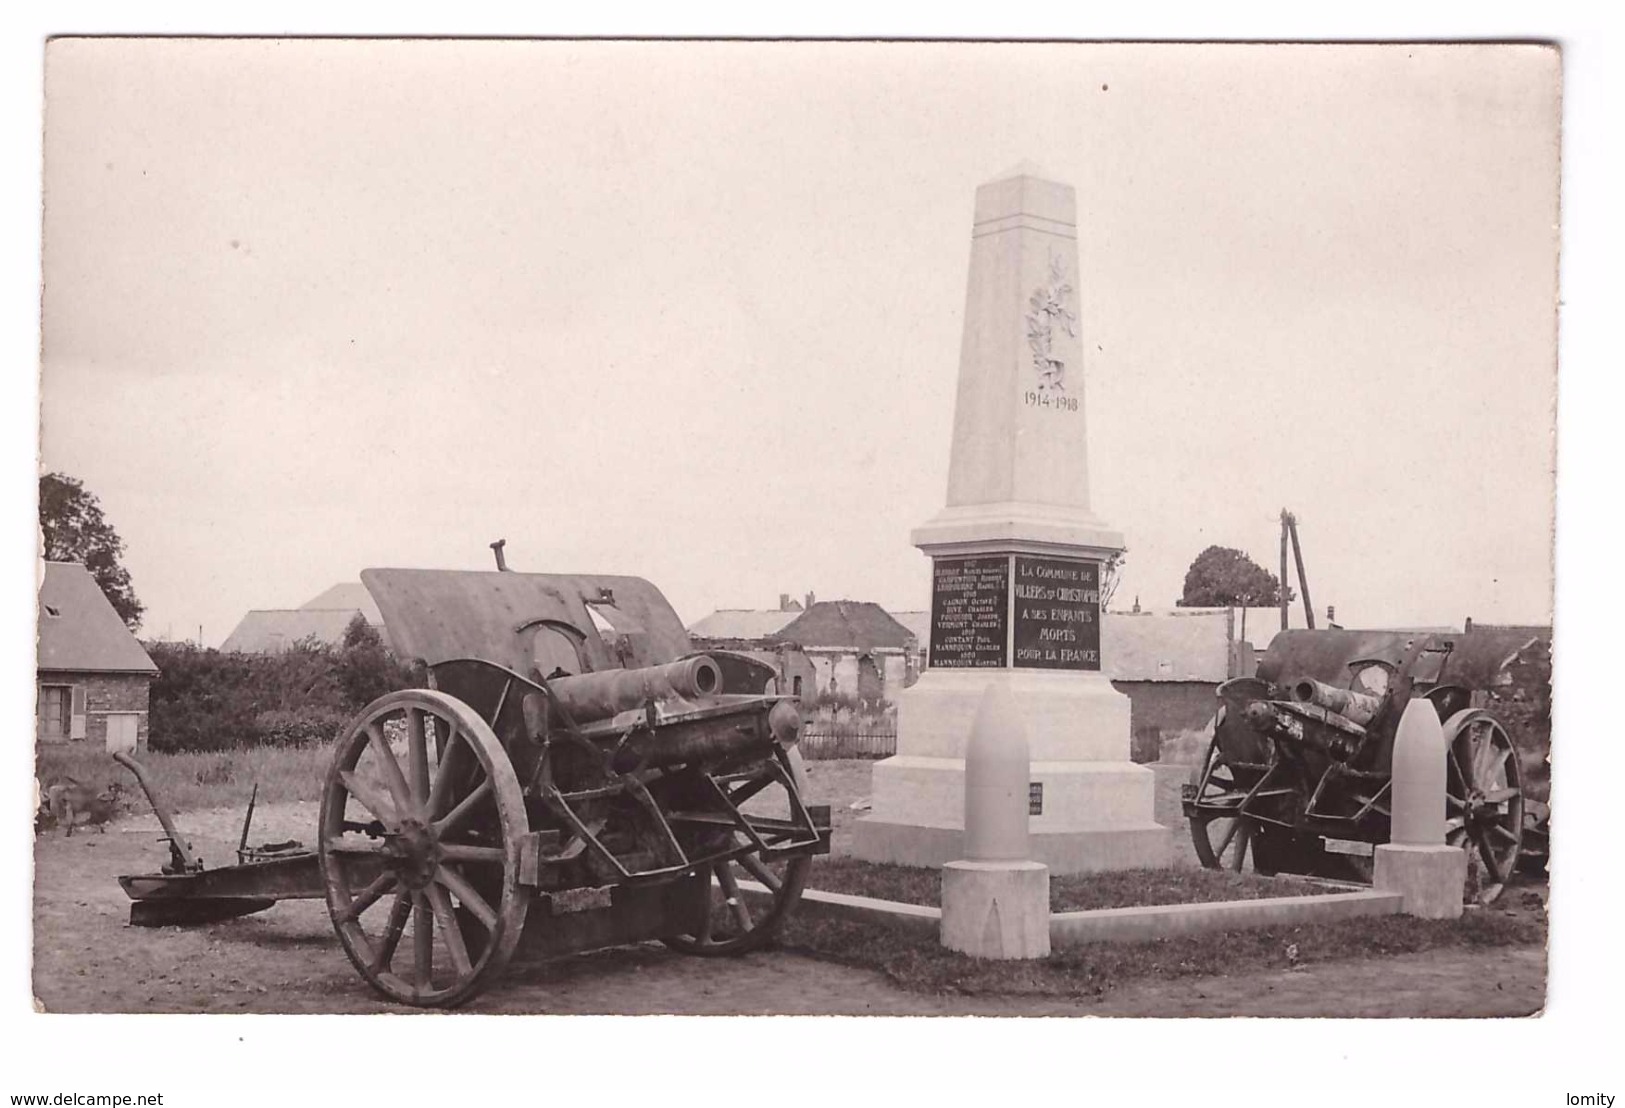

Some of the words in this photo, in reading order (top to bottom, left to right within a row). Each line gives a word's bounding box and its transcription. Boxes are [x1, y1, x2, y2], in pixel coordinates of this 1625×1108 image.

[1025, 391, 1078, 412] 1914-1918
[1031, 610, 1047, 620] SES
[1052, 609, 1092, 622] ENFANTS
[1040, 628, 1076, 641] MORTS
[1017, 649, 1041, 660] POUR
[1046, 650, 1056, 660] LA
[1061, 650, 1097, 662] FRANCE
